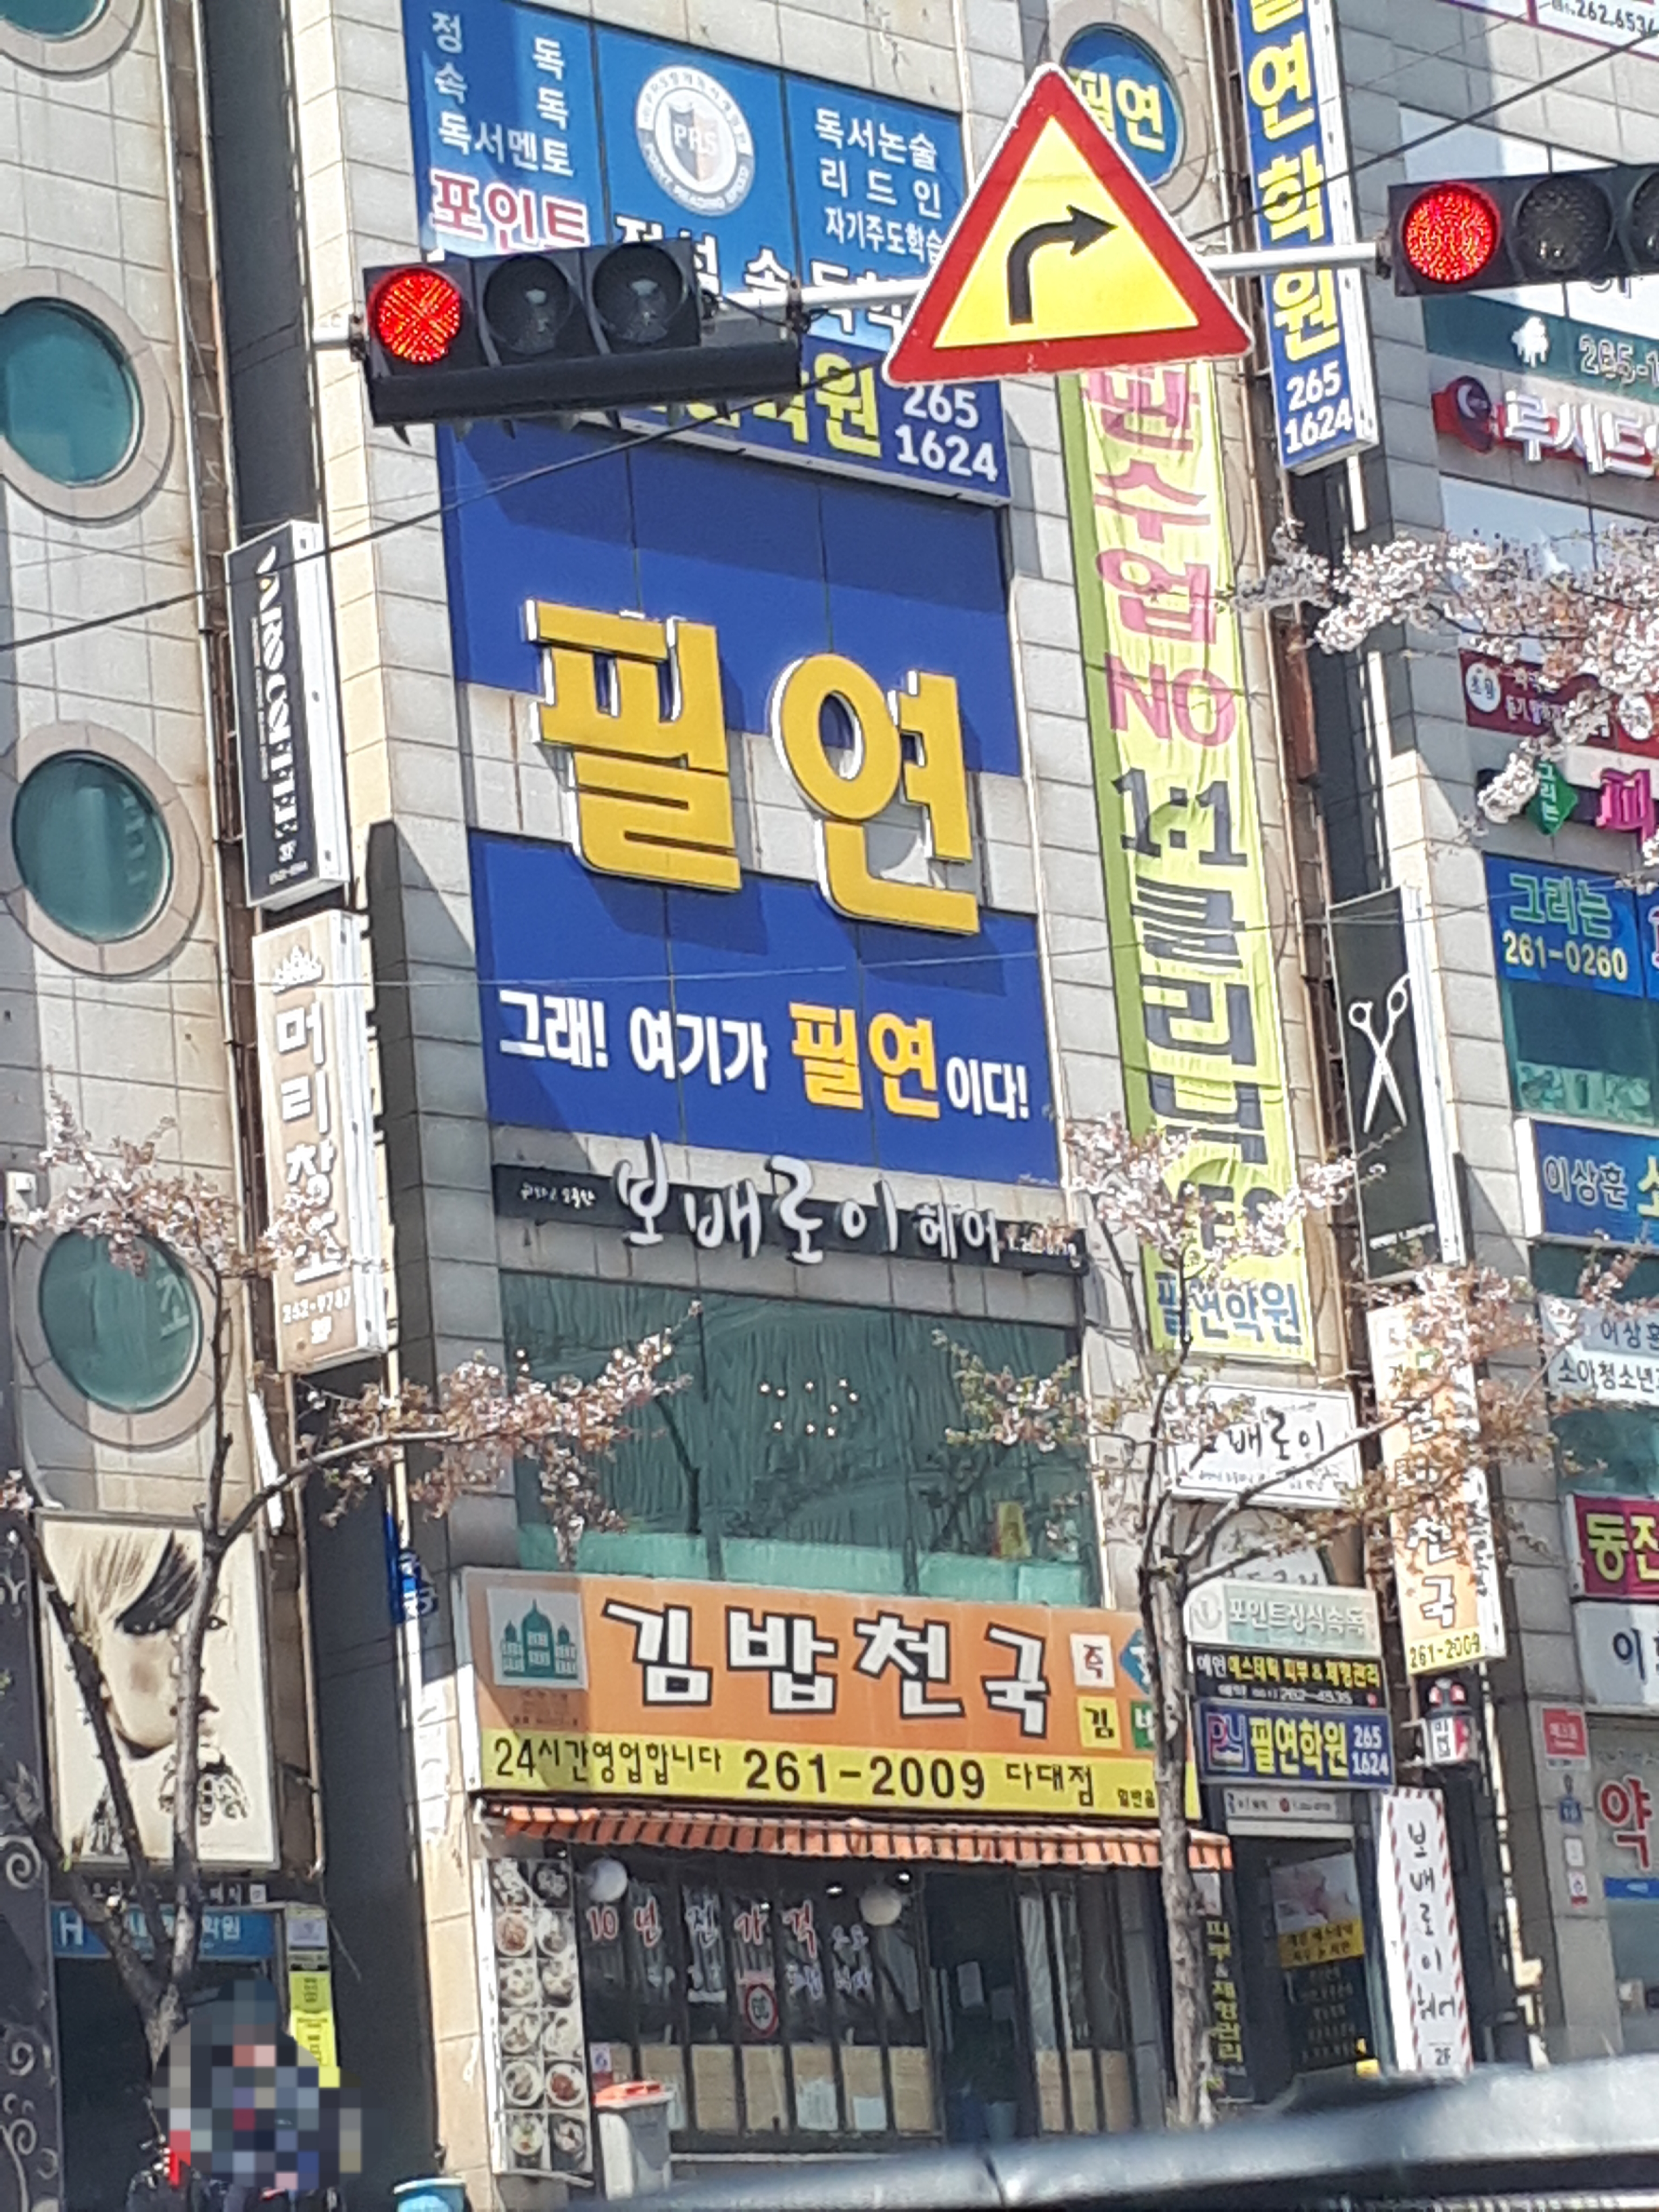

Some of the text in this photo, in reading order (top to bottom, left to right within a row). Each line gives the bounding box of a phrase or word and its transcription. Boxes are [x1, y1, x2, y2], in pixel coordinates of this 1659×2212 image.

[437, 110, 575, 178] 독서멘토
[814, 107, 938, 173] 독서논술
[430, 167, 591, 255] 포인트
[1247, 0, 1341, 362] 연학원
[824, 206, 944, 266] 자기주도학습
[902, 383, 980, 429] 265
[1287, 361, 1342, 413] 265
[895, 422, 999, 484] 1624
[1283, 398, 1354, 455] 1624
[1503, 389, 1659, 478] 루시드
[1105, 652, 1237, 747] NO
[523, 597, 980, 936] 필연
[1110, 767, 1247, 867] 1:1
[1502, 929, 1628, 981] 261-0260
[498, 989, 609, 1069] 그래!
[629, 1006, 768, 1091] 여기가
[1542, 1155, 1628, 1209] 이상훈
[916, 1202, 1000, 1264] 헤어
[1557, 1357, 1659, 1393] 소아청소년
[599, 1597, 1051, 1740] 김밥천국
[1083, 1707, 1115, 1739] 김
[1249, 1717, 1384, 1777] 필연학원 265
[743, 1748, 986, 1801] 261-2009
[1006, 1761, 1094, 1809] 다대점
[1351, 1751, 1390, 1777] 1624
